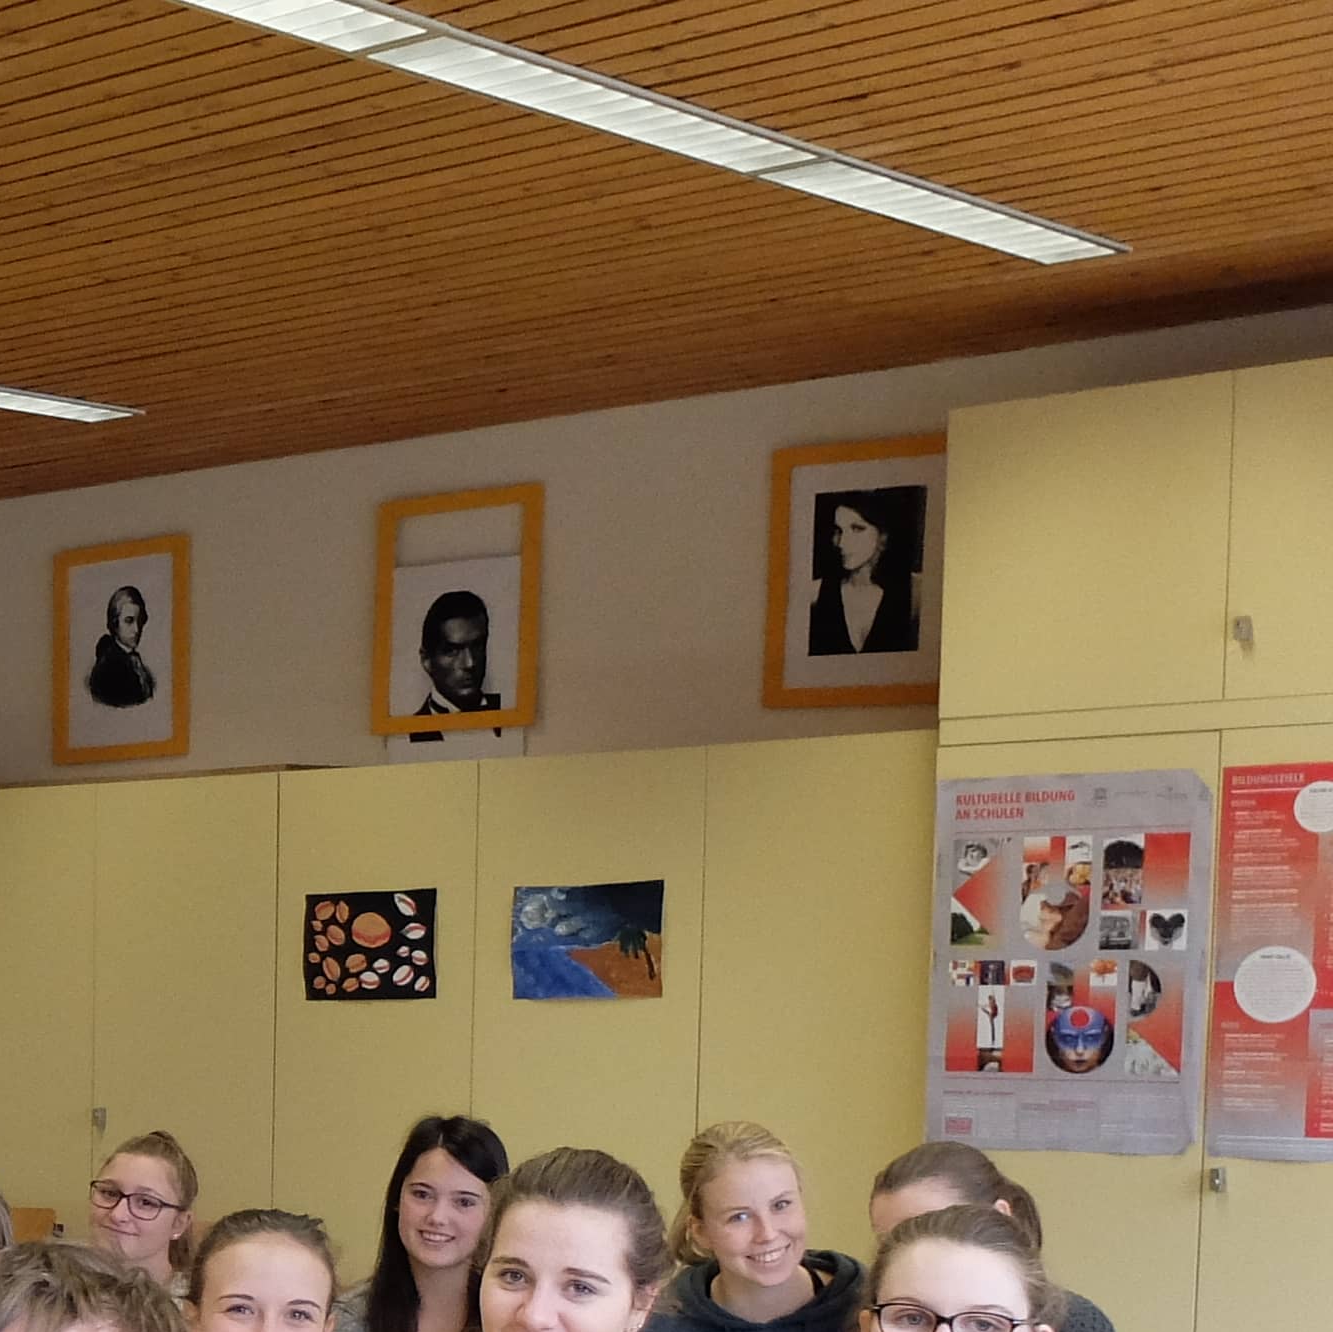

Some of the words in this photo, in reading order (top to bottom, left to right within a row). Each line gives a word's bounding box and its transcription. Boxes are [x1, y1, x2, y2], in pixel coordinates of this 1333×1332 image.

[956, 793, 1021, 806] KULTURELLE
[1025, 790, 1075, 803] BILDUNG
[955, 809, 970, 820] AN
[974, 807, 1024, 819] SCHULEN
